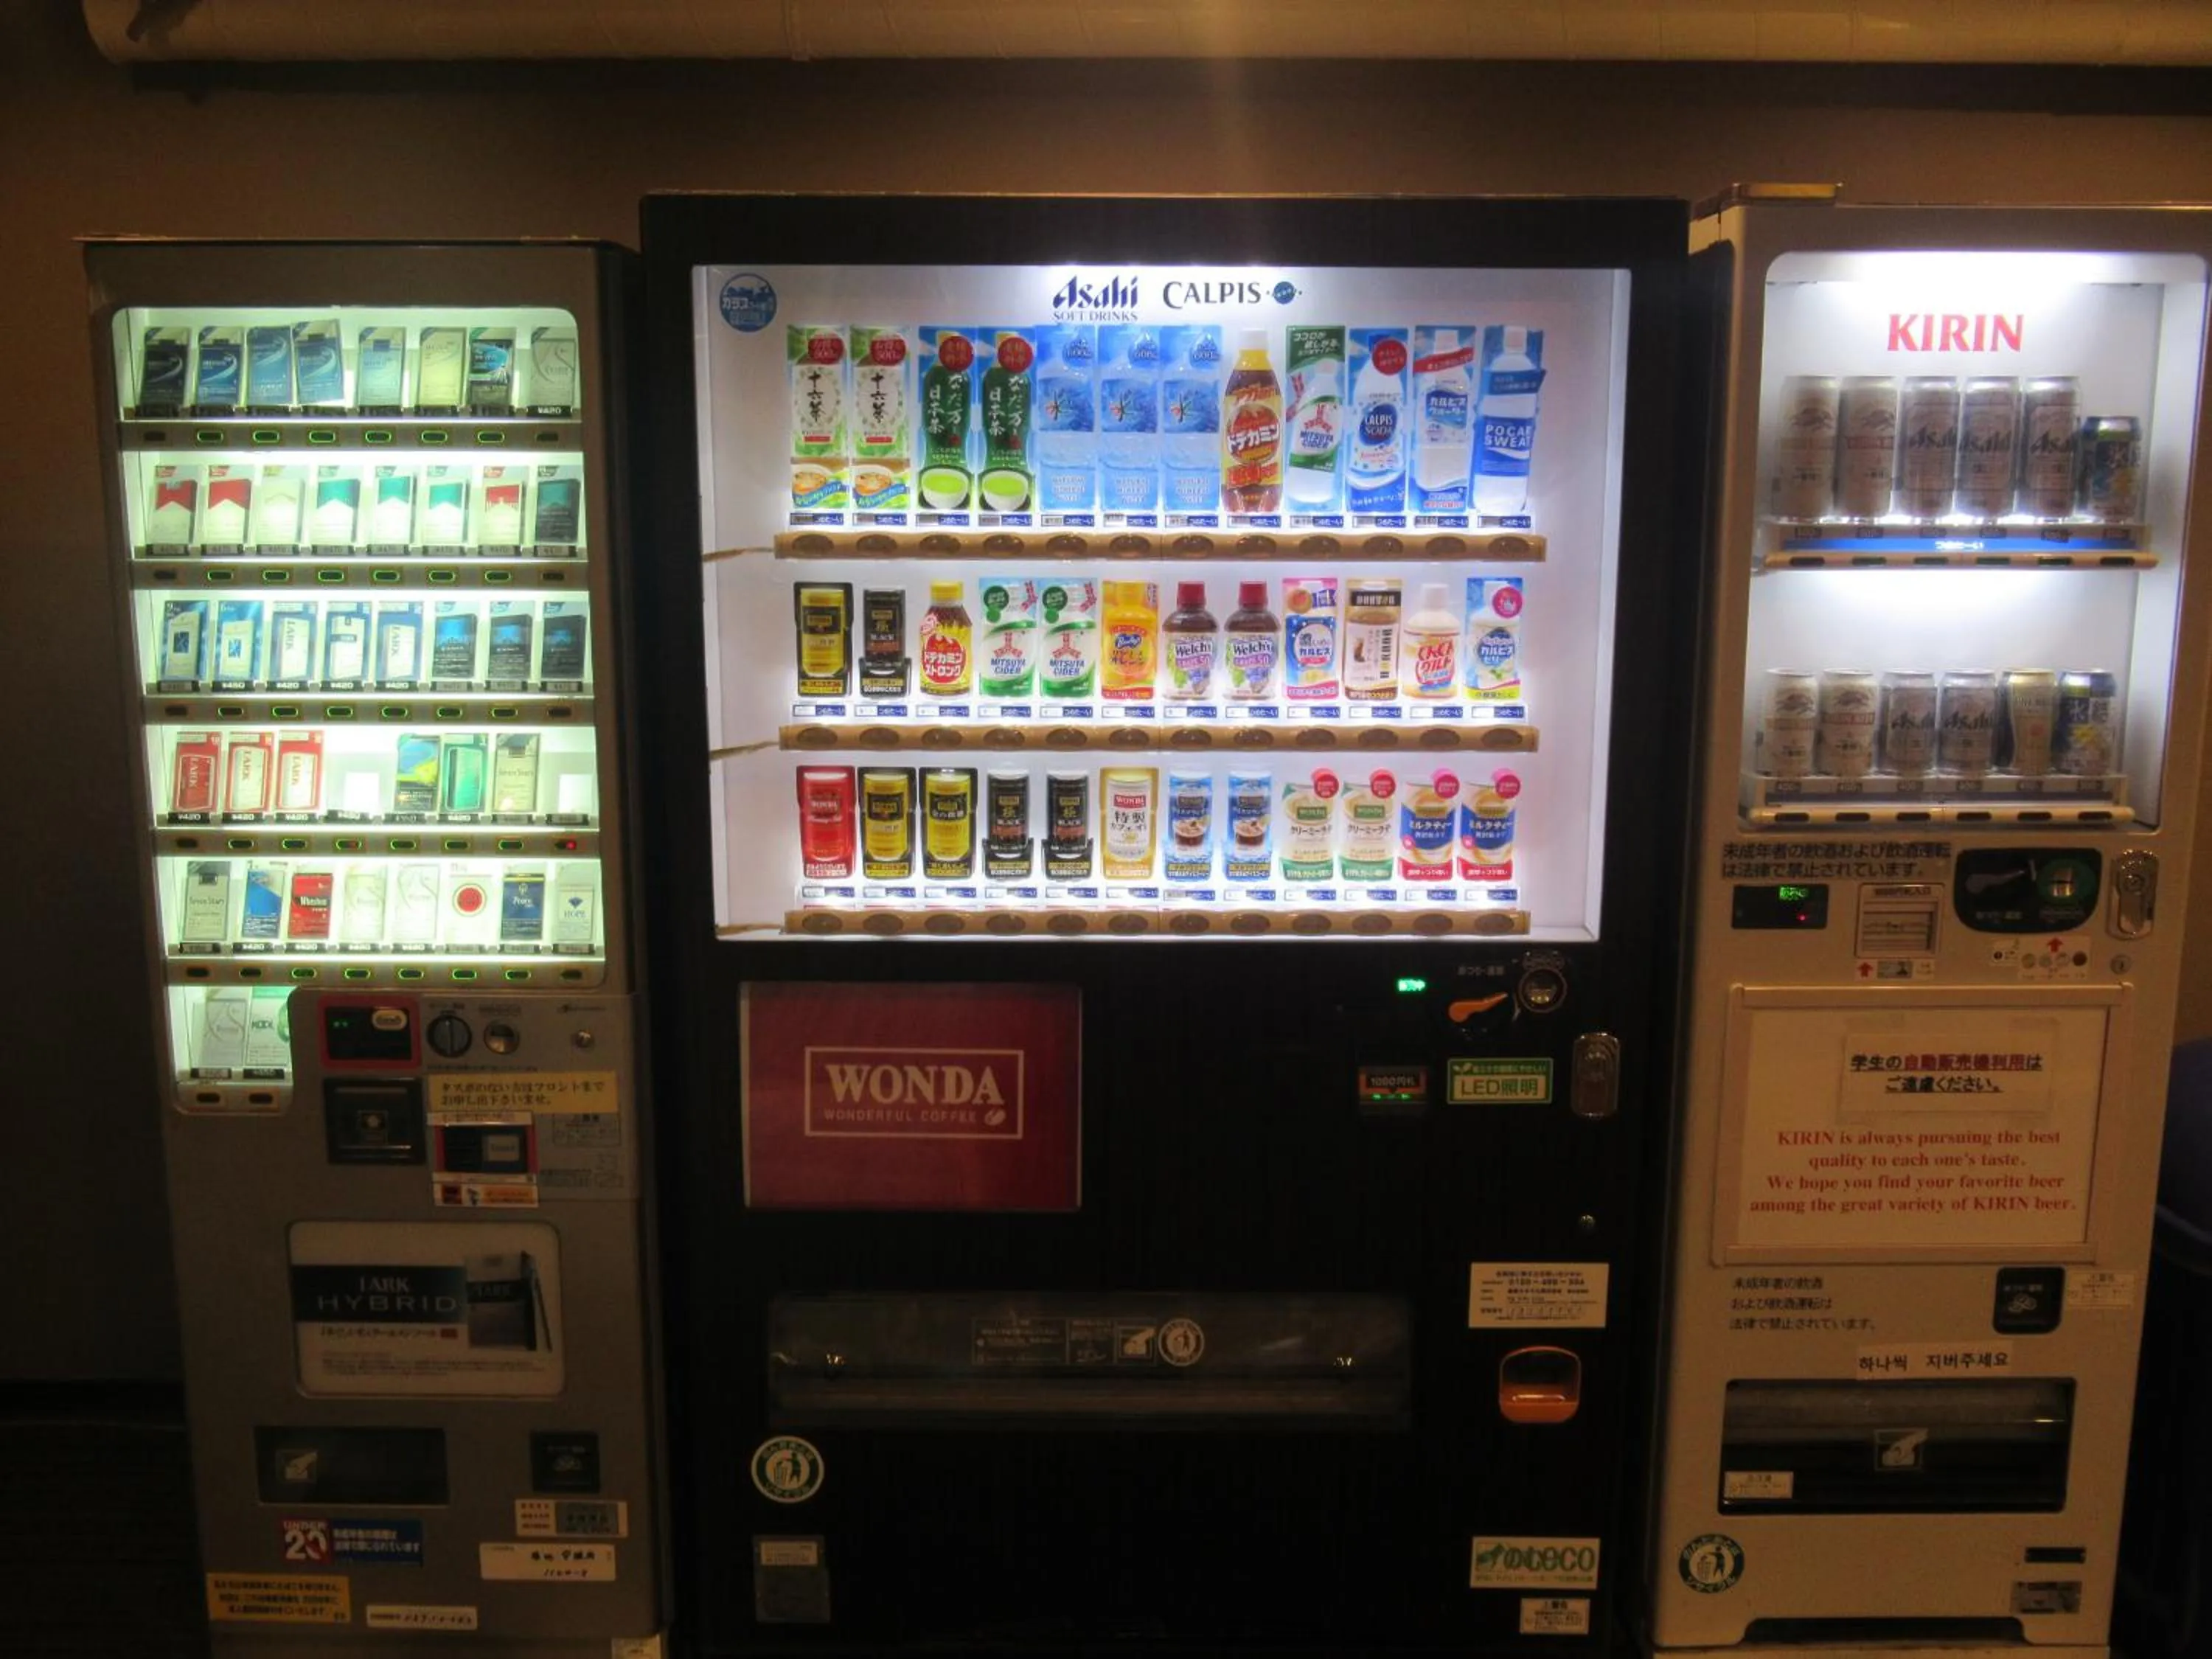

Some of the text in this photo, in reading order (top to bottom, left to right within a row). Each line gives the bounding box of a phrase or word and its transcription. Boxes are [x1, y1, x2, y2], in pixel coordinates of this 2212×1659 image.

[1053, 275, 1138, 309] Asahi
[1163, 281, 1262, 309] CALPIS
[1054, 311, 1138, 321] SOFT DRINKS
[1888, 313, 2024, 352] KIRIN
[808, 370, 826, 422] 十六茶
[871, 372, 887, 423] 十六茶
[1428, 397, 1468, 406] カルピス
[1365, 413, 1393, 425] CALPIS
[1226, 423, 1280, 453] ドデカミン
[1486, 425, 1531, 437] POCAR
[1484, 436, 1531, 448] SWEAT
[923, 651, 962, 664] ドデカミン
[924, 664, 961, 676] ストロング
[993, 666, 1021, 675] CIDER
[1054, 667, 1080, 676] CIDER
[1409, 819, 1452, 830] ミルクティー
[1470, 819, 1512, 830] ミルクティー
[1851, 1054, 2042, 1071] 学生の自動販売機利用は
[824, 1064, 1005, 1106] WONDA
[1461, 1079, 1539, 1096] LED照明
[1885, 1075, 2003, 1093] ご遠慮ください。
[824, 1108, 978, 1124] WONDERFUL COFFEE
[1778, 1131, 1834, 1145] KIRIN
[1841, 1130, 1852, 1144] is
[1858, 1130, 1914, 1147] always
[1997, 1130, 2023, 1143] the
[2028, 1130, 2061, 1143] best
[1809, 1152, 2026, 1170] quality to each one's taste.
[1767, 1174, 2065, 1192] We hope you find your favorite beer
[1750, 1195, 2076, 1214] among the great variety of KIRIN beer.
[359, 1276, 410, 1293] LARK
[316, 1294, 457, 1312] HYBRID
[1859, 1354, 1908, 1372] 하나씩
